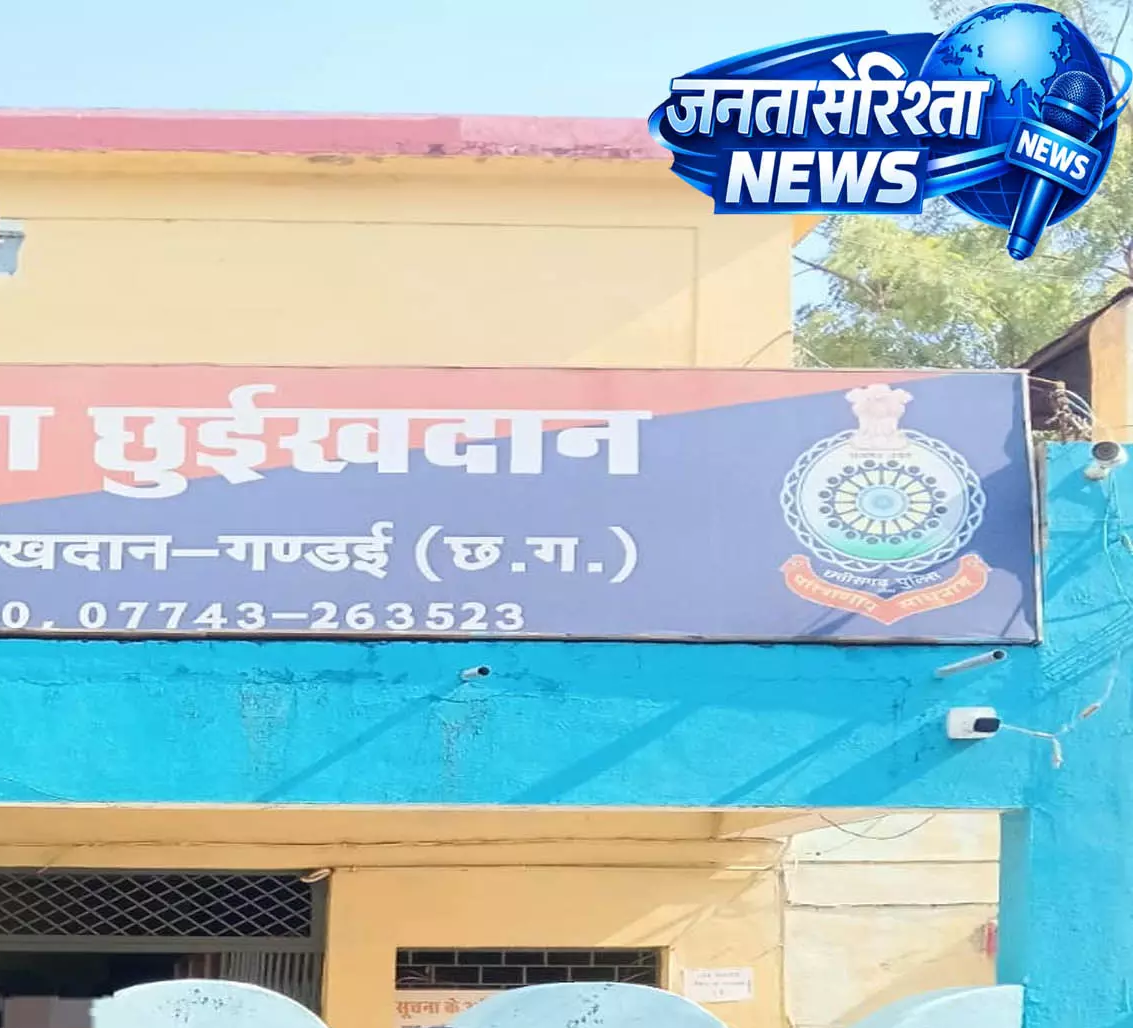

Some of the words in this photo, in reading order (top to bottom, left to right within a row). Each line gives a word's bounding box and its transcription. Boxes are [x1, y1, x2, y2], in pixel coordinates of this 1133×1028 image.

[87, 383, 653, 499] छुईखदान
[415, 525, 638, 583] (छ.ग.)
[78, 601, 525, 631] 07743-263523
